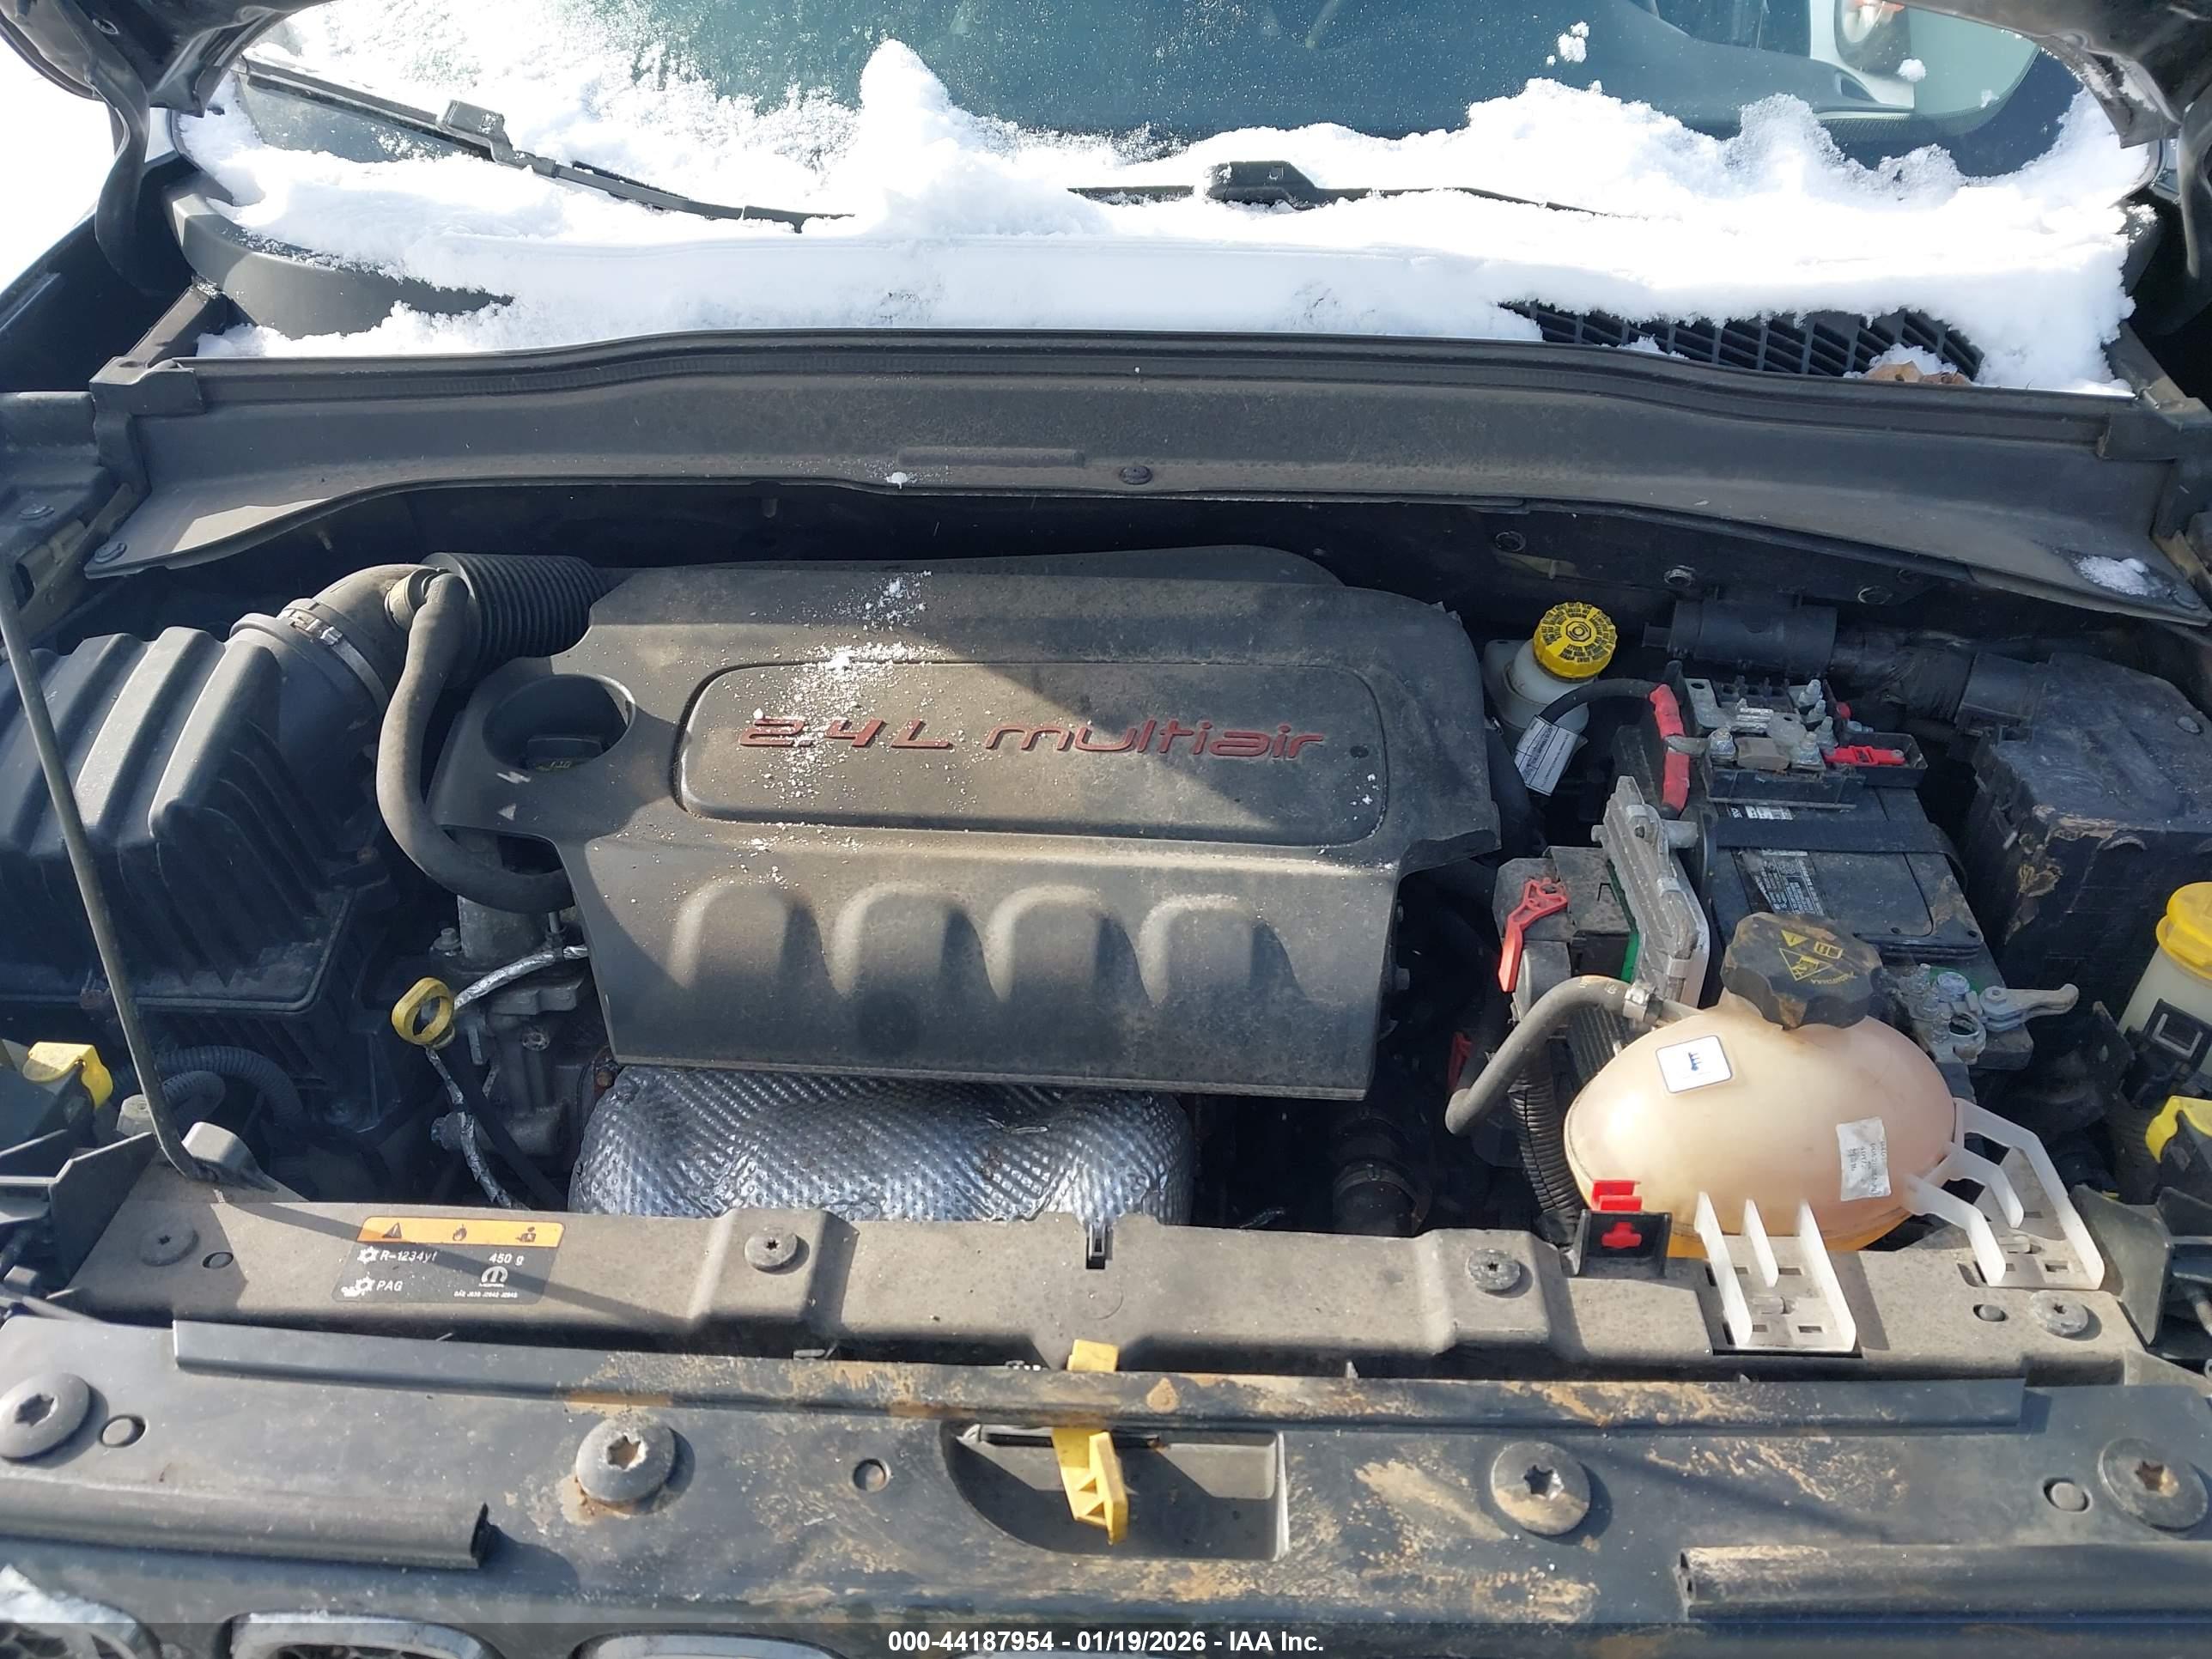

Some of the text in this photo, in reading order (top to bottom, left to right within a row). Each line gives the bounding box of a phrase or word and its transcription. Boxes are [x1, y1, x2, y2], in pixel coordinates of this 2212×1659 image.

[738, 717, 1324, 759] 2.4L multiair
[380, 1249, 438, 1264] R-1234yf
[489, 1253, 525, 1267] 450 g
[376, 1279, 404, 1291] PAG
